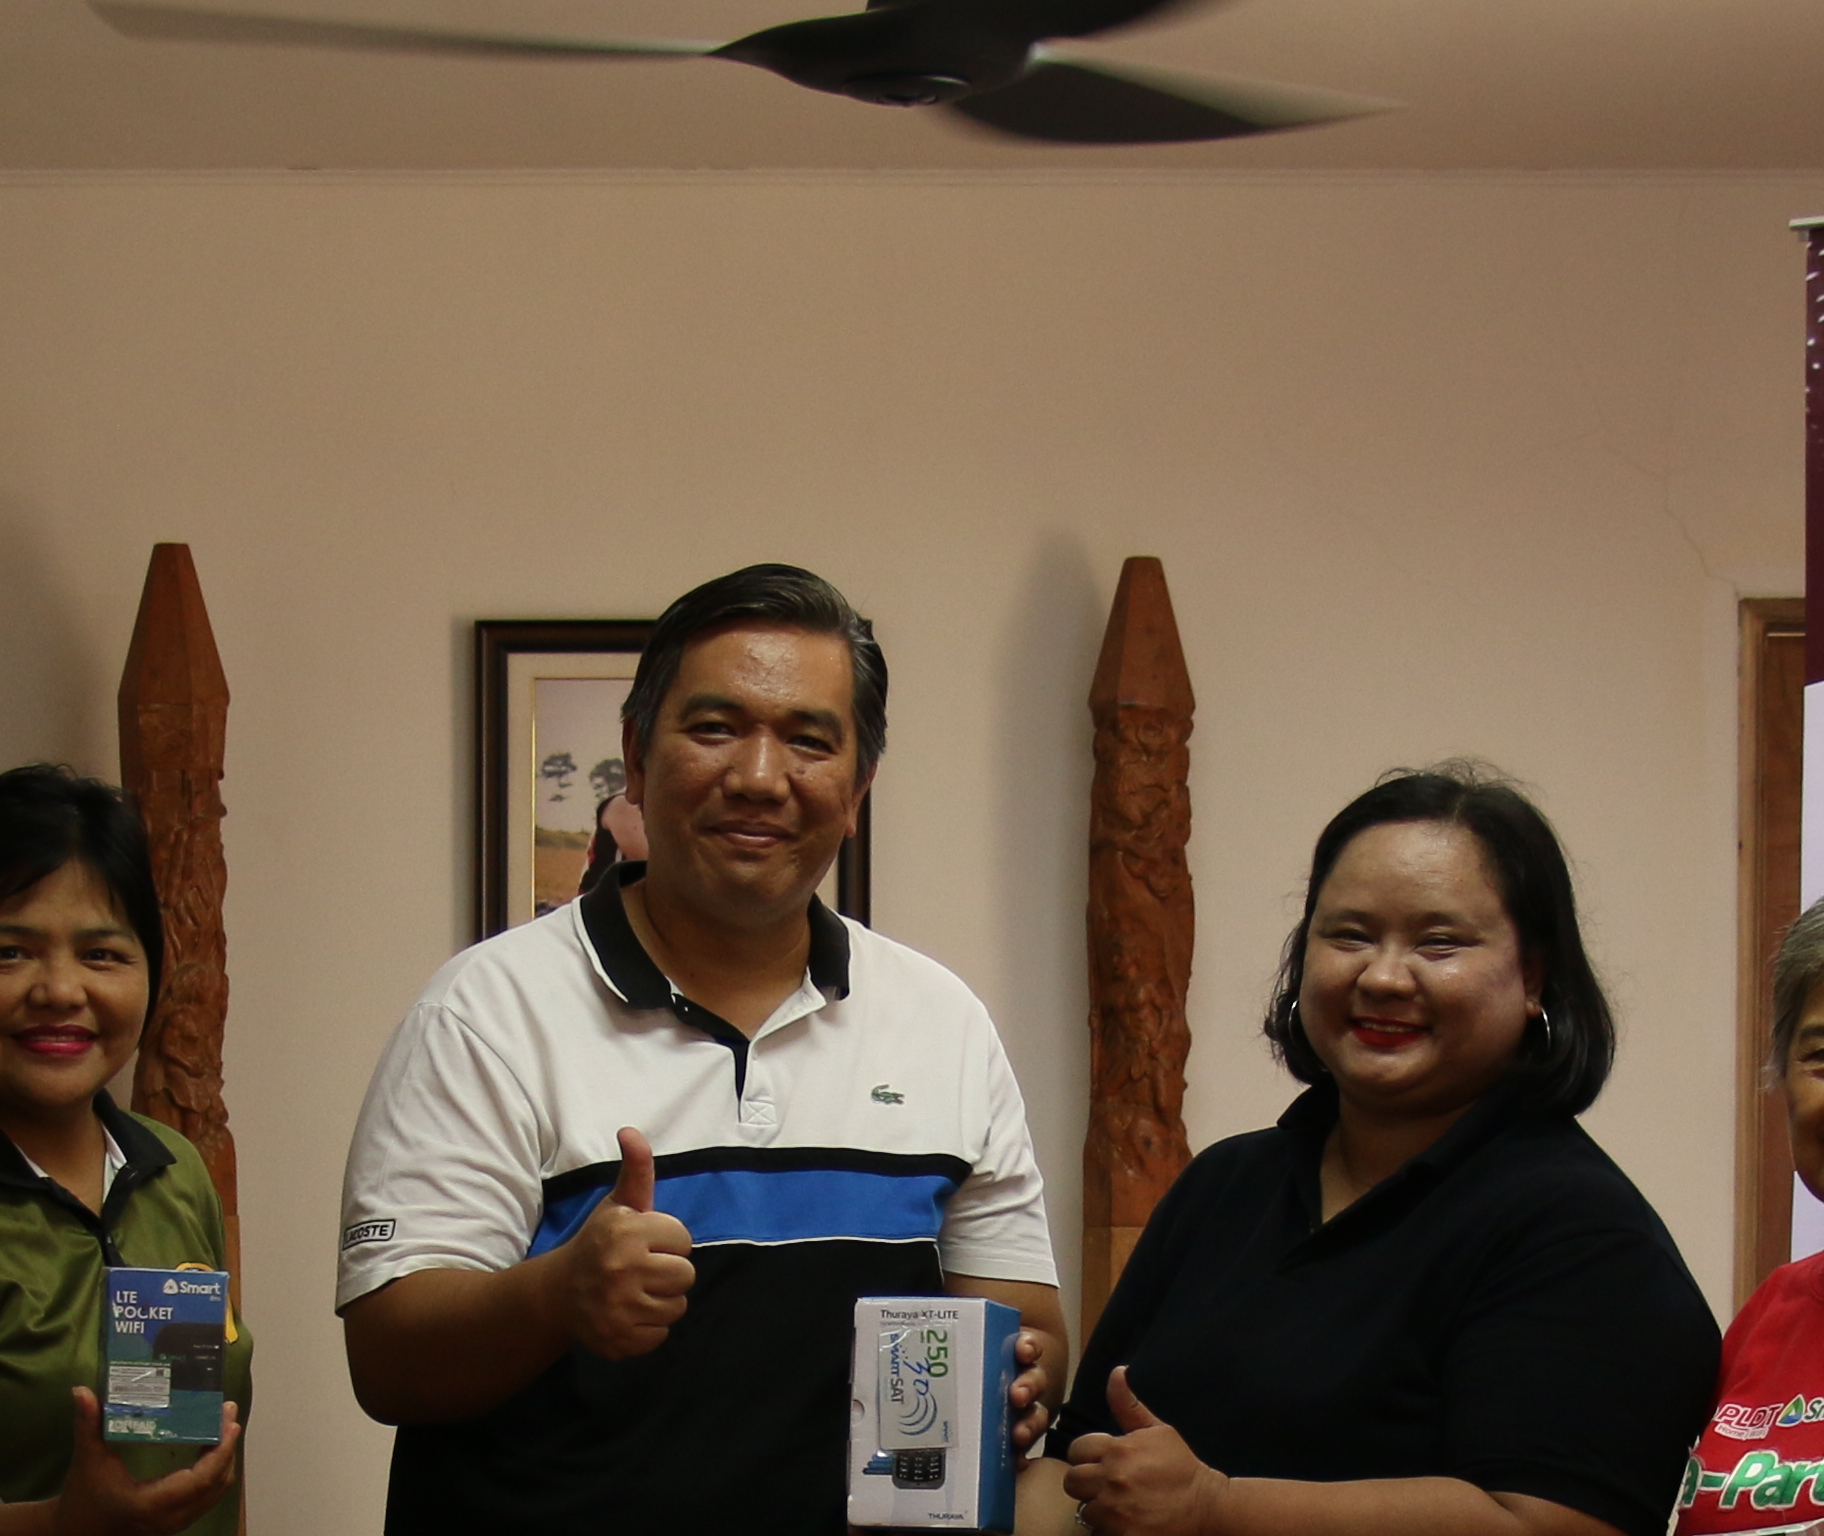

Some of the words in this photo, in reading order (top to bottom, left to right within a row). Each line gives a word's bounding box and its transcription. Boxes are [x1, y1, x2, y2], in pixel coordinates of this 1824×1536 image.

[179, 1280, 222, 1295] Smart
[116, 1290, 138, 1304] LTE
[115, 1305, 174, 1320] POCKET
[880, 1309, 919, 1321] Thuraya
[115, 1320, 145, 1334] WIFI
[927, 1329, 949, 1378] 250
[1716, 1405, 1780, 1428] PLDT
